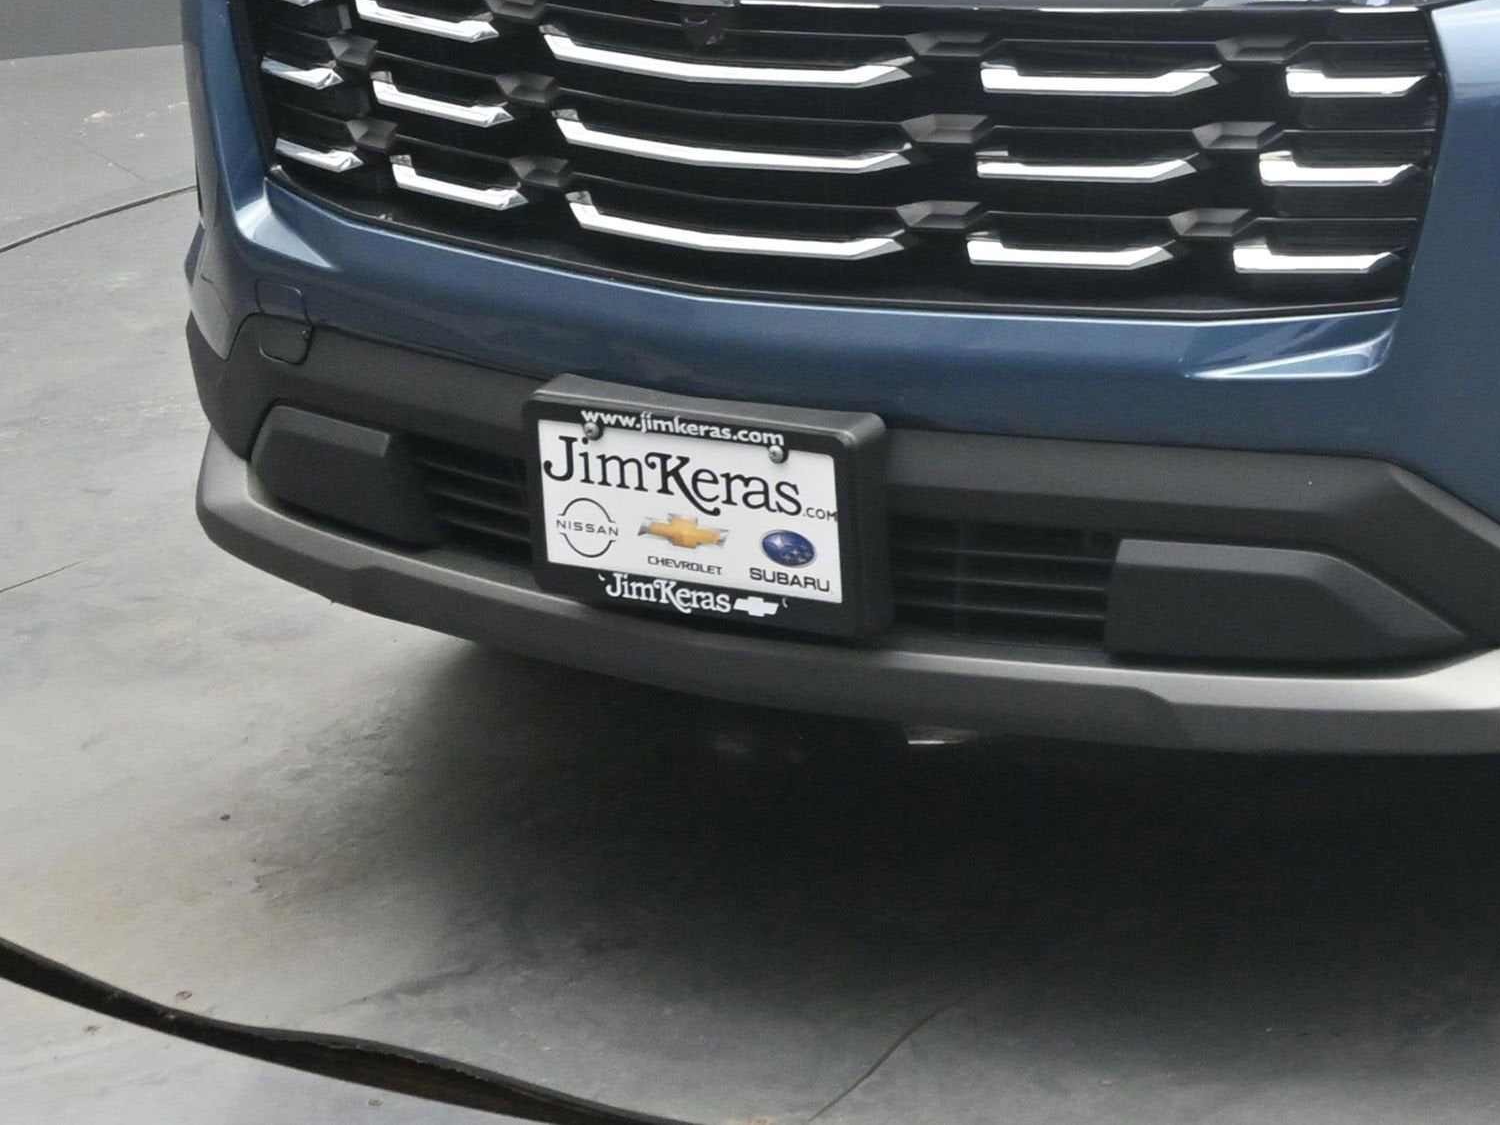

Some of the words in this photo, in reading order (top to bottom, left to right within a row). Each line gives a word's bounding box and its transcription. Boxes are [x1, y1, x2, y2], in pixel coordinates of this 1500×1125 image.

[581, 410, 785, 446] www.jimkeras.com
[556, 519, 619, 536] NISSAN
[647, 555, 722, 575] CHEVROLET
[749, 567, 830, 592] SUBARU
